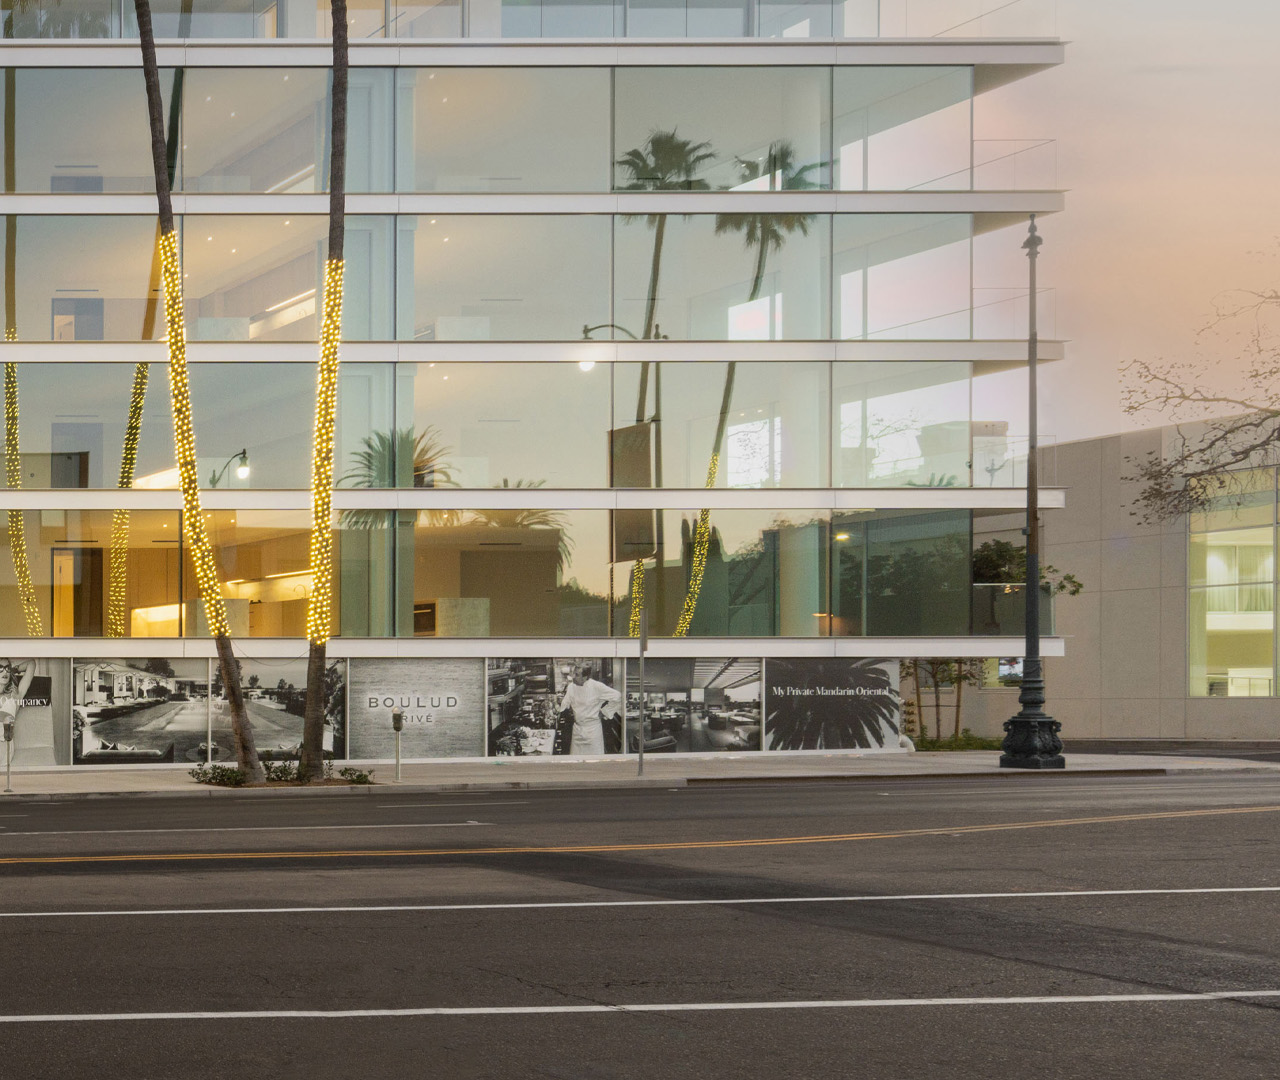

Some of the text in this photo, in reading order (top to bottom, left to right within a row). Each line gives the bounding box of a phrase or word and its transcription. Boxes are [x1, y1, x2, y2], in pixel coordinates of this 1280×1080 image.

[772, 686, 889, 697] My Private Mandarin Oriental
[0, 696, 49, 707] Oupancy
[368, 697, 458, 708] BOULUD
[401, 713, 433, 723] RIVÉ
